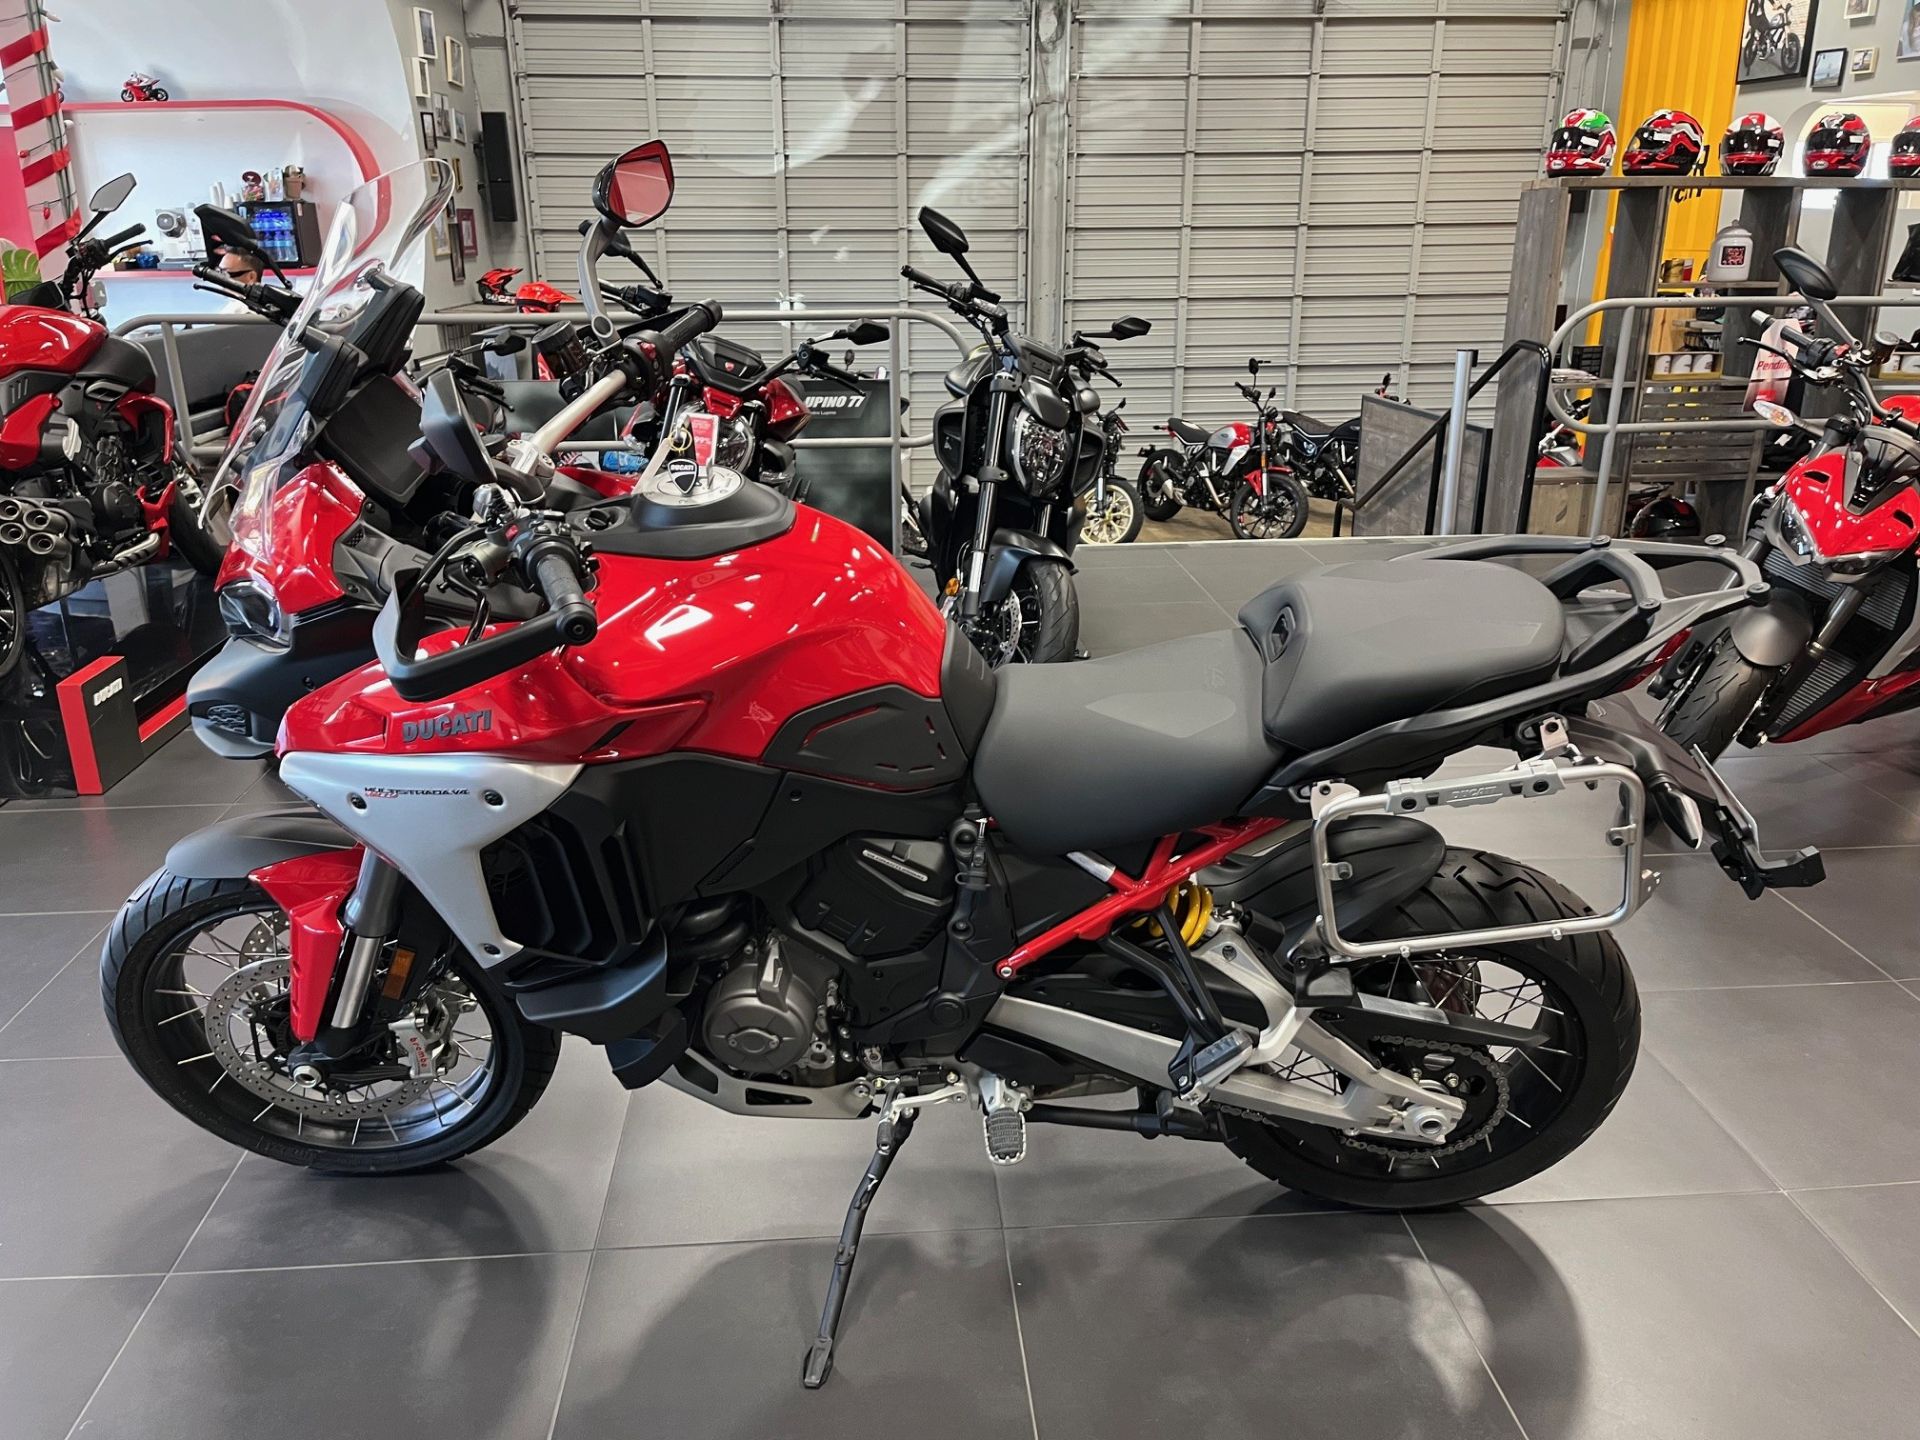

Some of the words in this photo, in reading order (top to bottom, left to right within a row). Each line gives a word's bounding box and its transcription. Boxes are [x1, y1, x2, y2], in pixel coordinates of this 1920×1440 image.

[485, 293, 516, 304] DUCAT
[402, 710, 492, 742] DUCATI
[409, 1036, 428, 1068] brembo
